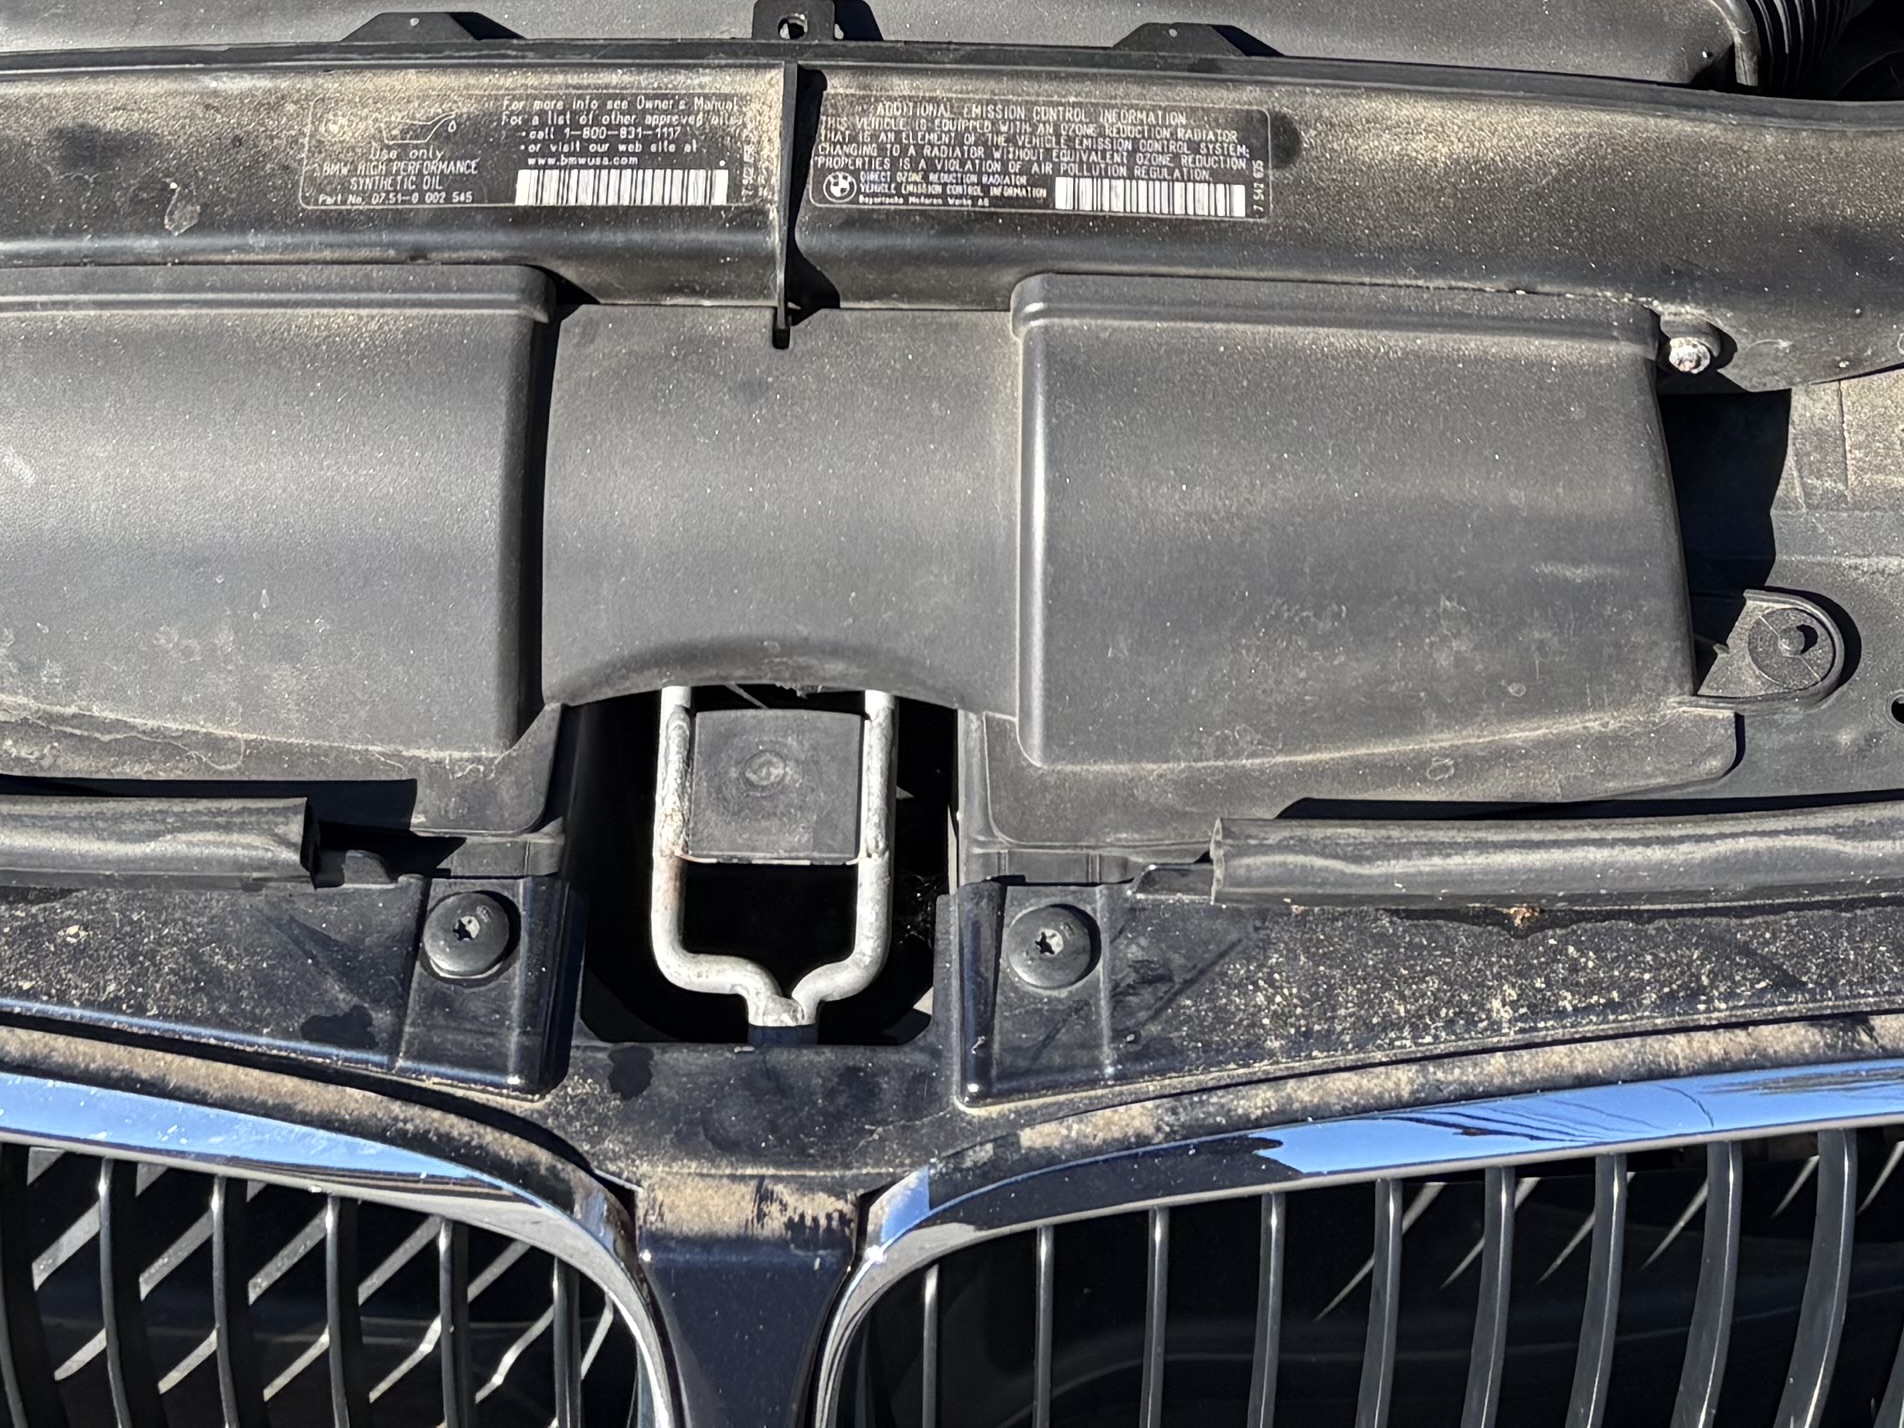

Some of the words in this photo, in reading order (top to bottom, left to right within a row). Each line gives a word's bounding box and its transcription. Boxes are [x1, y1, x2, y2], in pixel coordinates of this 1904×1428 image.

[503, 99, 524, 111] For
[534, 98, 563, 110] more
[573, 96, 597, 110] info
[607, 99, 628, 109] see
[501, 113, 523, 126] For
[532, 115, 539, 125] a
[548, 111, 570, 125] list
[579, 111, 593, 125] of
[602, 111, 636, 125] other
[645, 111, 703, 126] approved
[876, 102, 952, 118] ADDITIONAL
[963, 104, 1025, 119] EMISSION
[1033, 106, 1087, 122] CONTROL
[1100, 109, 1186, 125] INFORMATION
[529, 127, 554, 139] call
[820, 116, 847, 130] THIS
[857, 117, 906, 131] VEHICLE
[915, 119, 926, 131] IS
[935, 119, 991, 133] EQUIPPED
[999, 120, 1030, 133] WITH
[1036, 122, 1053, 135] AN
[1061, 122, 1096, 135] OZONE
[1105, 123, 1170, 138] REDUCTION
[1178, 127, 1238, 142] RADIATOR
[528, 144, 540, 152] or
[550, 140, 579, 152] visit
[589, 142, 609, 152] our
[618, 140, 642, 152] web
[651, 140, 675, 152] site
[684, 140, 697, 152] at
[820, 129, 849, 142] THAT
[859, 131, 871, 142] IS
[878, 131, 895, 143] AN
[902, 131, 955, 144] ELEMENT
[964, 133, 976, 145] OF
[988, 133, 1007, 146] THE
[1017, 134, 1068, 149] VEHICLE
[1075, 136, 1132, 151] EMISSION
[1139, 138, 1191, 154] CONTROL
[370, 146, 397, 159] Use
[410, 149, 444, 161] only
[528, 155, 638, 165] www.bmwusa.com
[818, 143, 878, 156] CHANGING
[887, 144, 900, 157] TO
[908, 145, 916, 157] A
[923, 145, 985, 159] RADIATOR
[992, 147, 1045, 160] WITHOUT
[1052, 148, 1128, 164] EQUIVALENT
[1136, 152, 1174, 167] OZONE
[1181, 154, 1246, 170] REDUCTION
[323, 163, 348, 176] BMW
[357, 161, 386, 175] HIGH
[393, 158, 479, 175] PERFORMANCE
[817, 157, 891, 170] PROPERTIES
[899, 157, 910, 170] IS
[918, 158, 926, 170] A
[935, 158, 1001, 172] VIOLATION
[1008, 160, 1022, 173] OF
[1031, 162, 1053, 175] AIR
[1060, 162, 1127, 176] POLLUTION
[1134, 167, 1213, 181] REGULATION.
[350, 176, 416, 190] SYNTHETIC
[423, 176, 443, 190] OIL
[860, 171, 891, 182] DIRECT
[897, 172, 924, 183] OZONE
[929, 173, 978, 184] REDUCTION
[982, 174, 1028, 185] RADIATOR
[860, 183, 896, 194] VEHICLE
[946, 185, 983, 196] CONTROL
[989, 186, 1047, 198] INFORMATION
[319, 194, 341, 204] Part
[426, 193, 444, 203] 002
